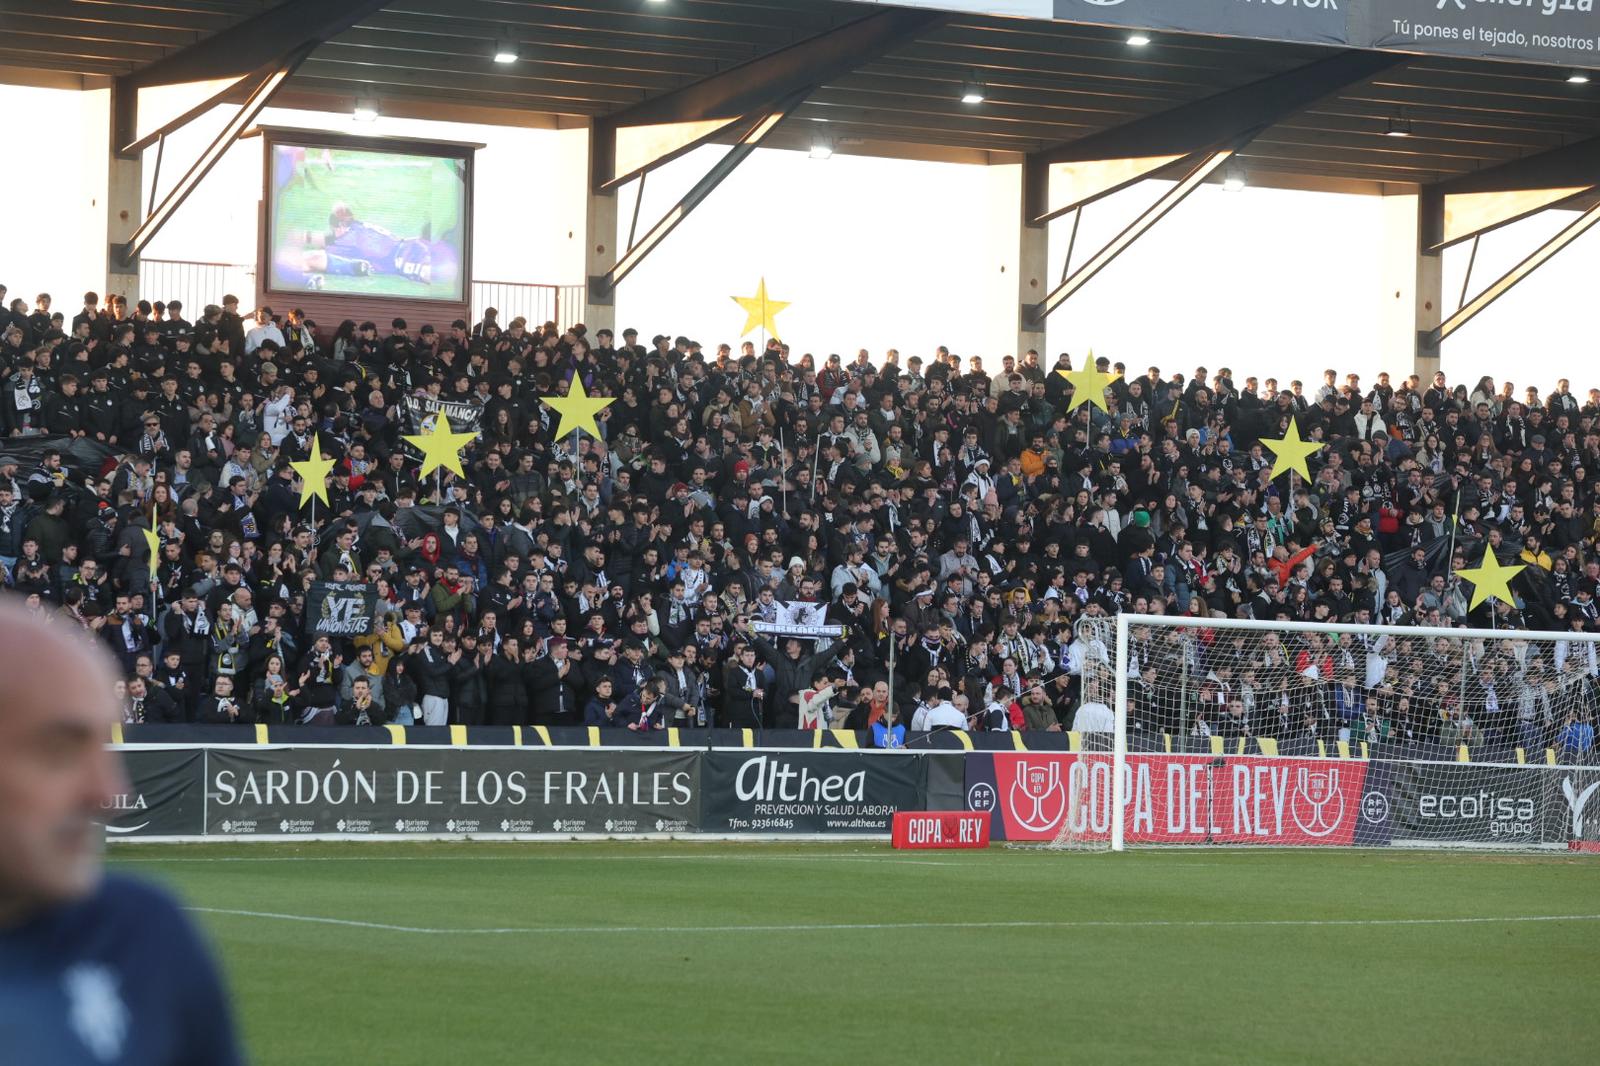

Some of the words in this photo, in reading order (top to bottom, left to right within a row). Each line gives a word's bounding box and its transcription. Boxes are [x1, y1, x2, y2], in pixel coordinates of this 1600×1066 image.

[1393, 19, 1409, 34] Tú
[1414, 23, 1459, 40] pones
[1462, 26, 1475, 40] el
[1479, 28, 1528, 47] tejado,
[1532, 34, 1594, 50] nosotros
[425, 400, 477, 420] SALMANCA
[215, 758, 376, 805] SARDÓN
[396, 770, 444, 805] DE
[460, 770, 527, 806] LOS
[544, 771, 692, 806] FRAILES
[1069, 761, 1154, 833] COPA
[1167, 763, 1222, 834] DEL
[1233, 764, 1288, 836] REY
[754, 804, 815, 815] PREVENCION
[816, 805, 824, 815] Y
[728, 818, 750, 829] Tfno.
[752, 818, 794, 829] 923616845
[827, 819, 886, 828] www.althea.es
[908, 818, 942, 844] COPA
[959, 818, 982, 843] REY
[1490, 821, 1533, 836] grupo
